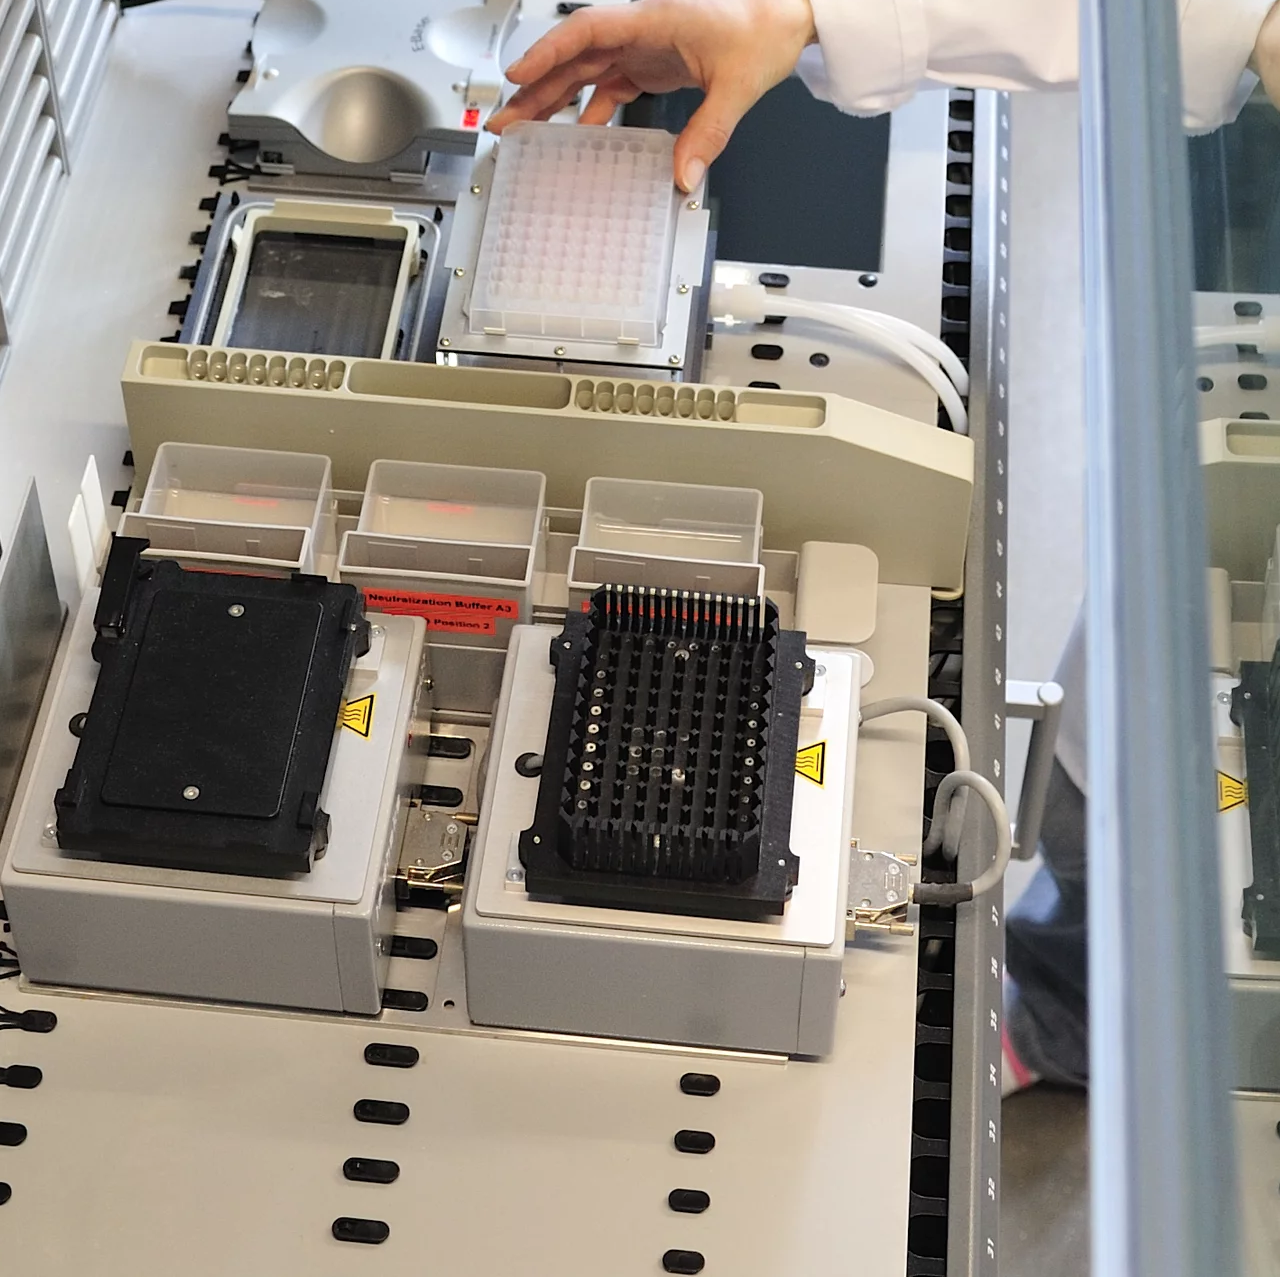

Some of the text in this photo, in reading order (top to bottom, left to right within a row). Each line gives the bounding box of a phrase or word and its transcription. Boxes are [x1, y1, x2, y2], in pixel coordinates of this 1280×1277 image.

[369, 593, 512, 613] Neutralization Buffer A3
[434, 618, 480, 630] Position
[992, 905, 999, 927] 37
[990, 956, 998, 978] 36
[990, 1009, 998, 1032] 35
[989, 1063, 997, 1087] 34
[988, 1118, 997, 1144] 33
[987, 1177, 996, 1201] 32
[986, 1237, 995, 1260] 31
